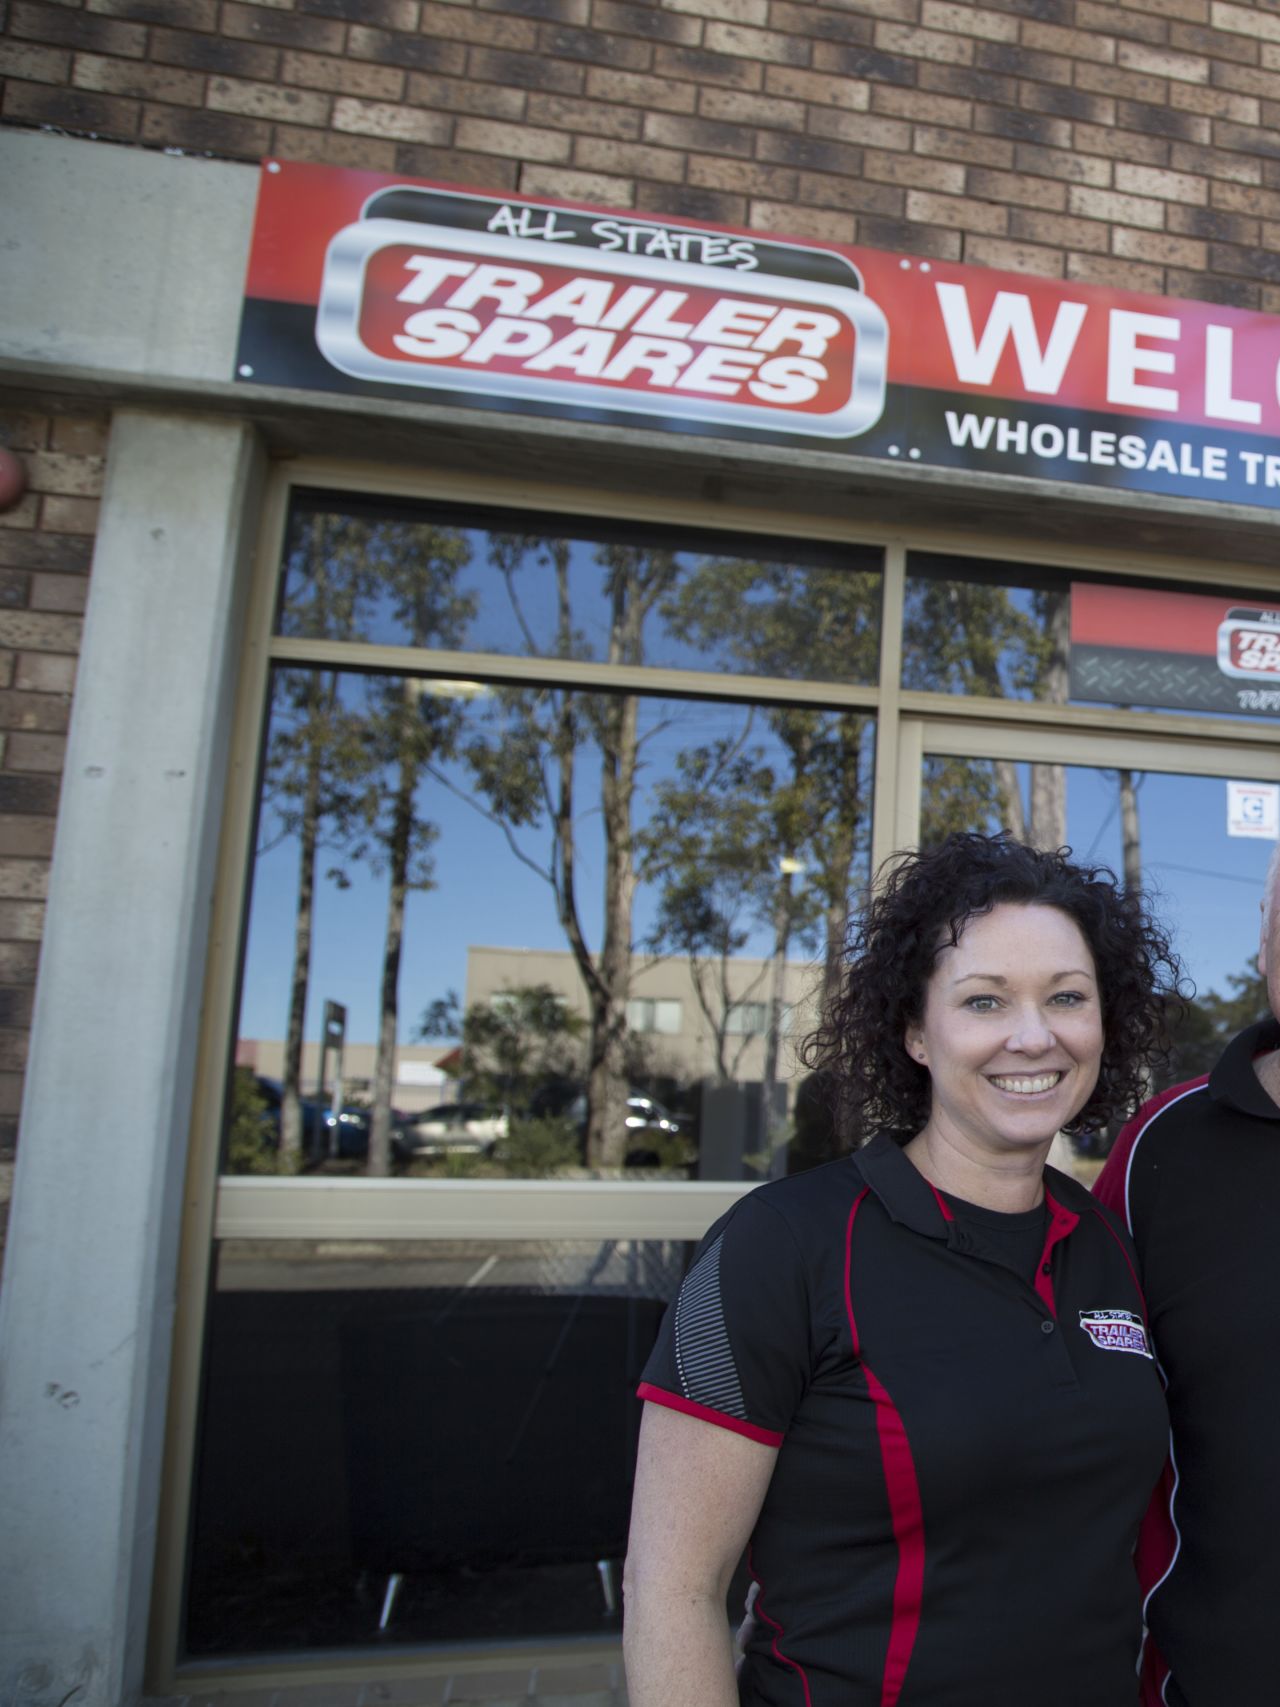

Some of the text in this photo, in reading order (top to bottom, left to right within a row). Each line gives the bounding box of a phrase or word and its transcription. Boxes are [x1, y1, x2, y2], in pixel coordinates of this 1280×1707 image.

[487, 205, 760, 271] ALL STATES
[396, 254, 841, 359] TRAILER
[392, 307, 829, 404] SPARES
[945, 411, 1227, 482] WHOLESALE
[1090, 1325, 1143, 1340] TRAILER
[1097, 1335, 1146, 1352] SPARES
